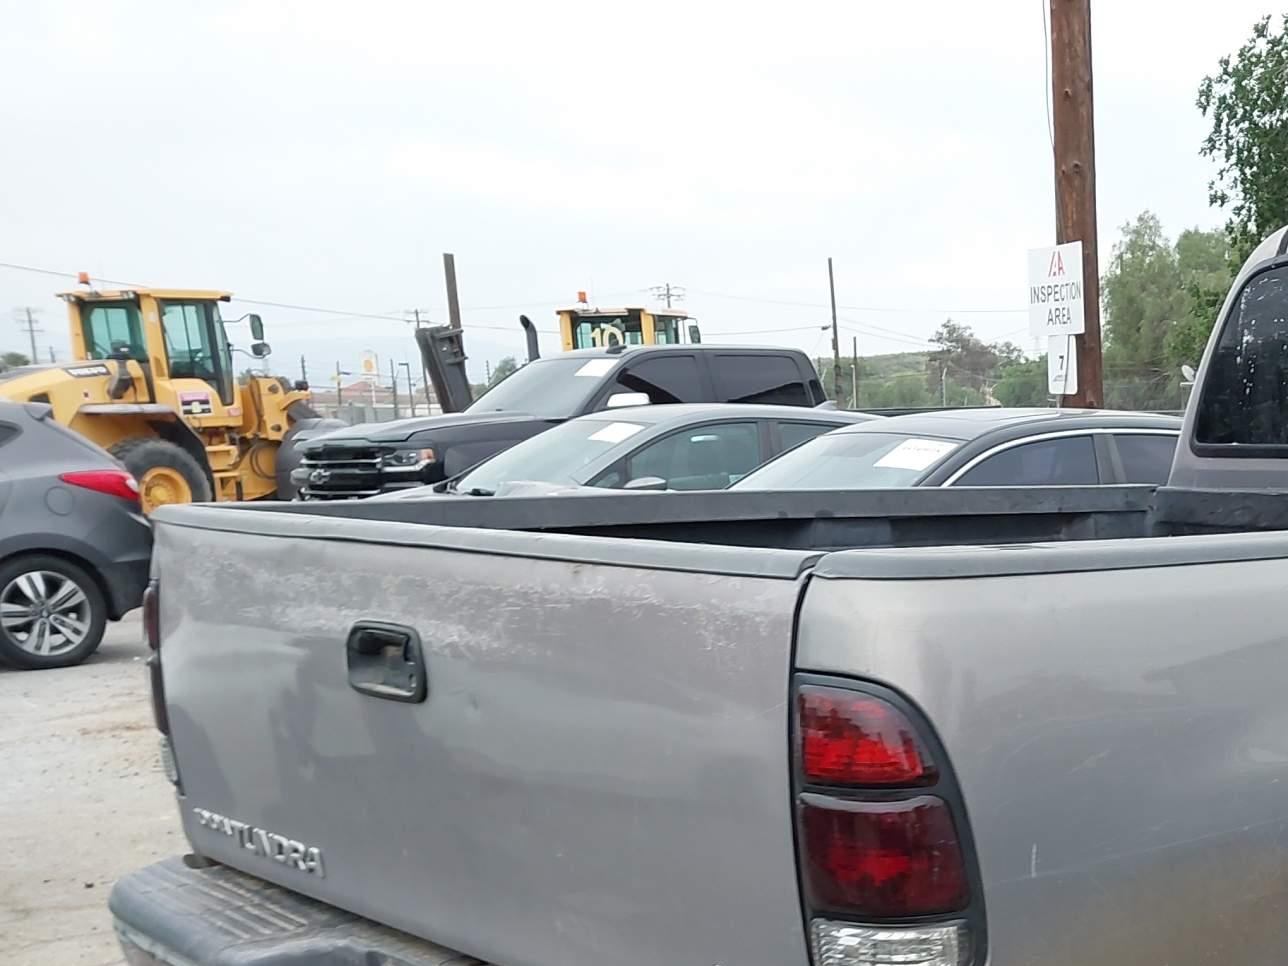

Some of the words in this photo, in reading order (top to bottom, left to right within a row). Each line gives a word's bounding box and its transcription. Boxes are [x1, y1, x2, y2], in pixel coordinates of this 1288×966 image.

[1030, 281, 1082, 305] INSPECTION
[1047, 306, 1072, 326] AREA
[1058, 355, 1065, 371] 7
[229, 819, 326, 879] TUNDRA
